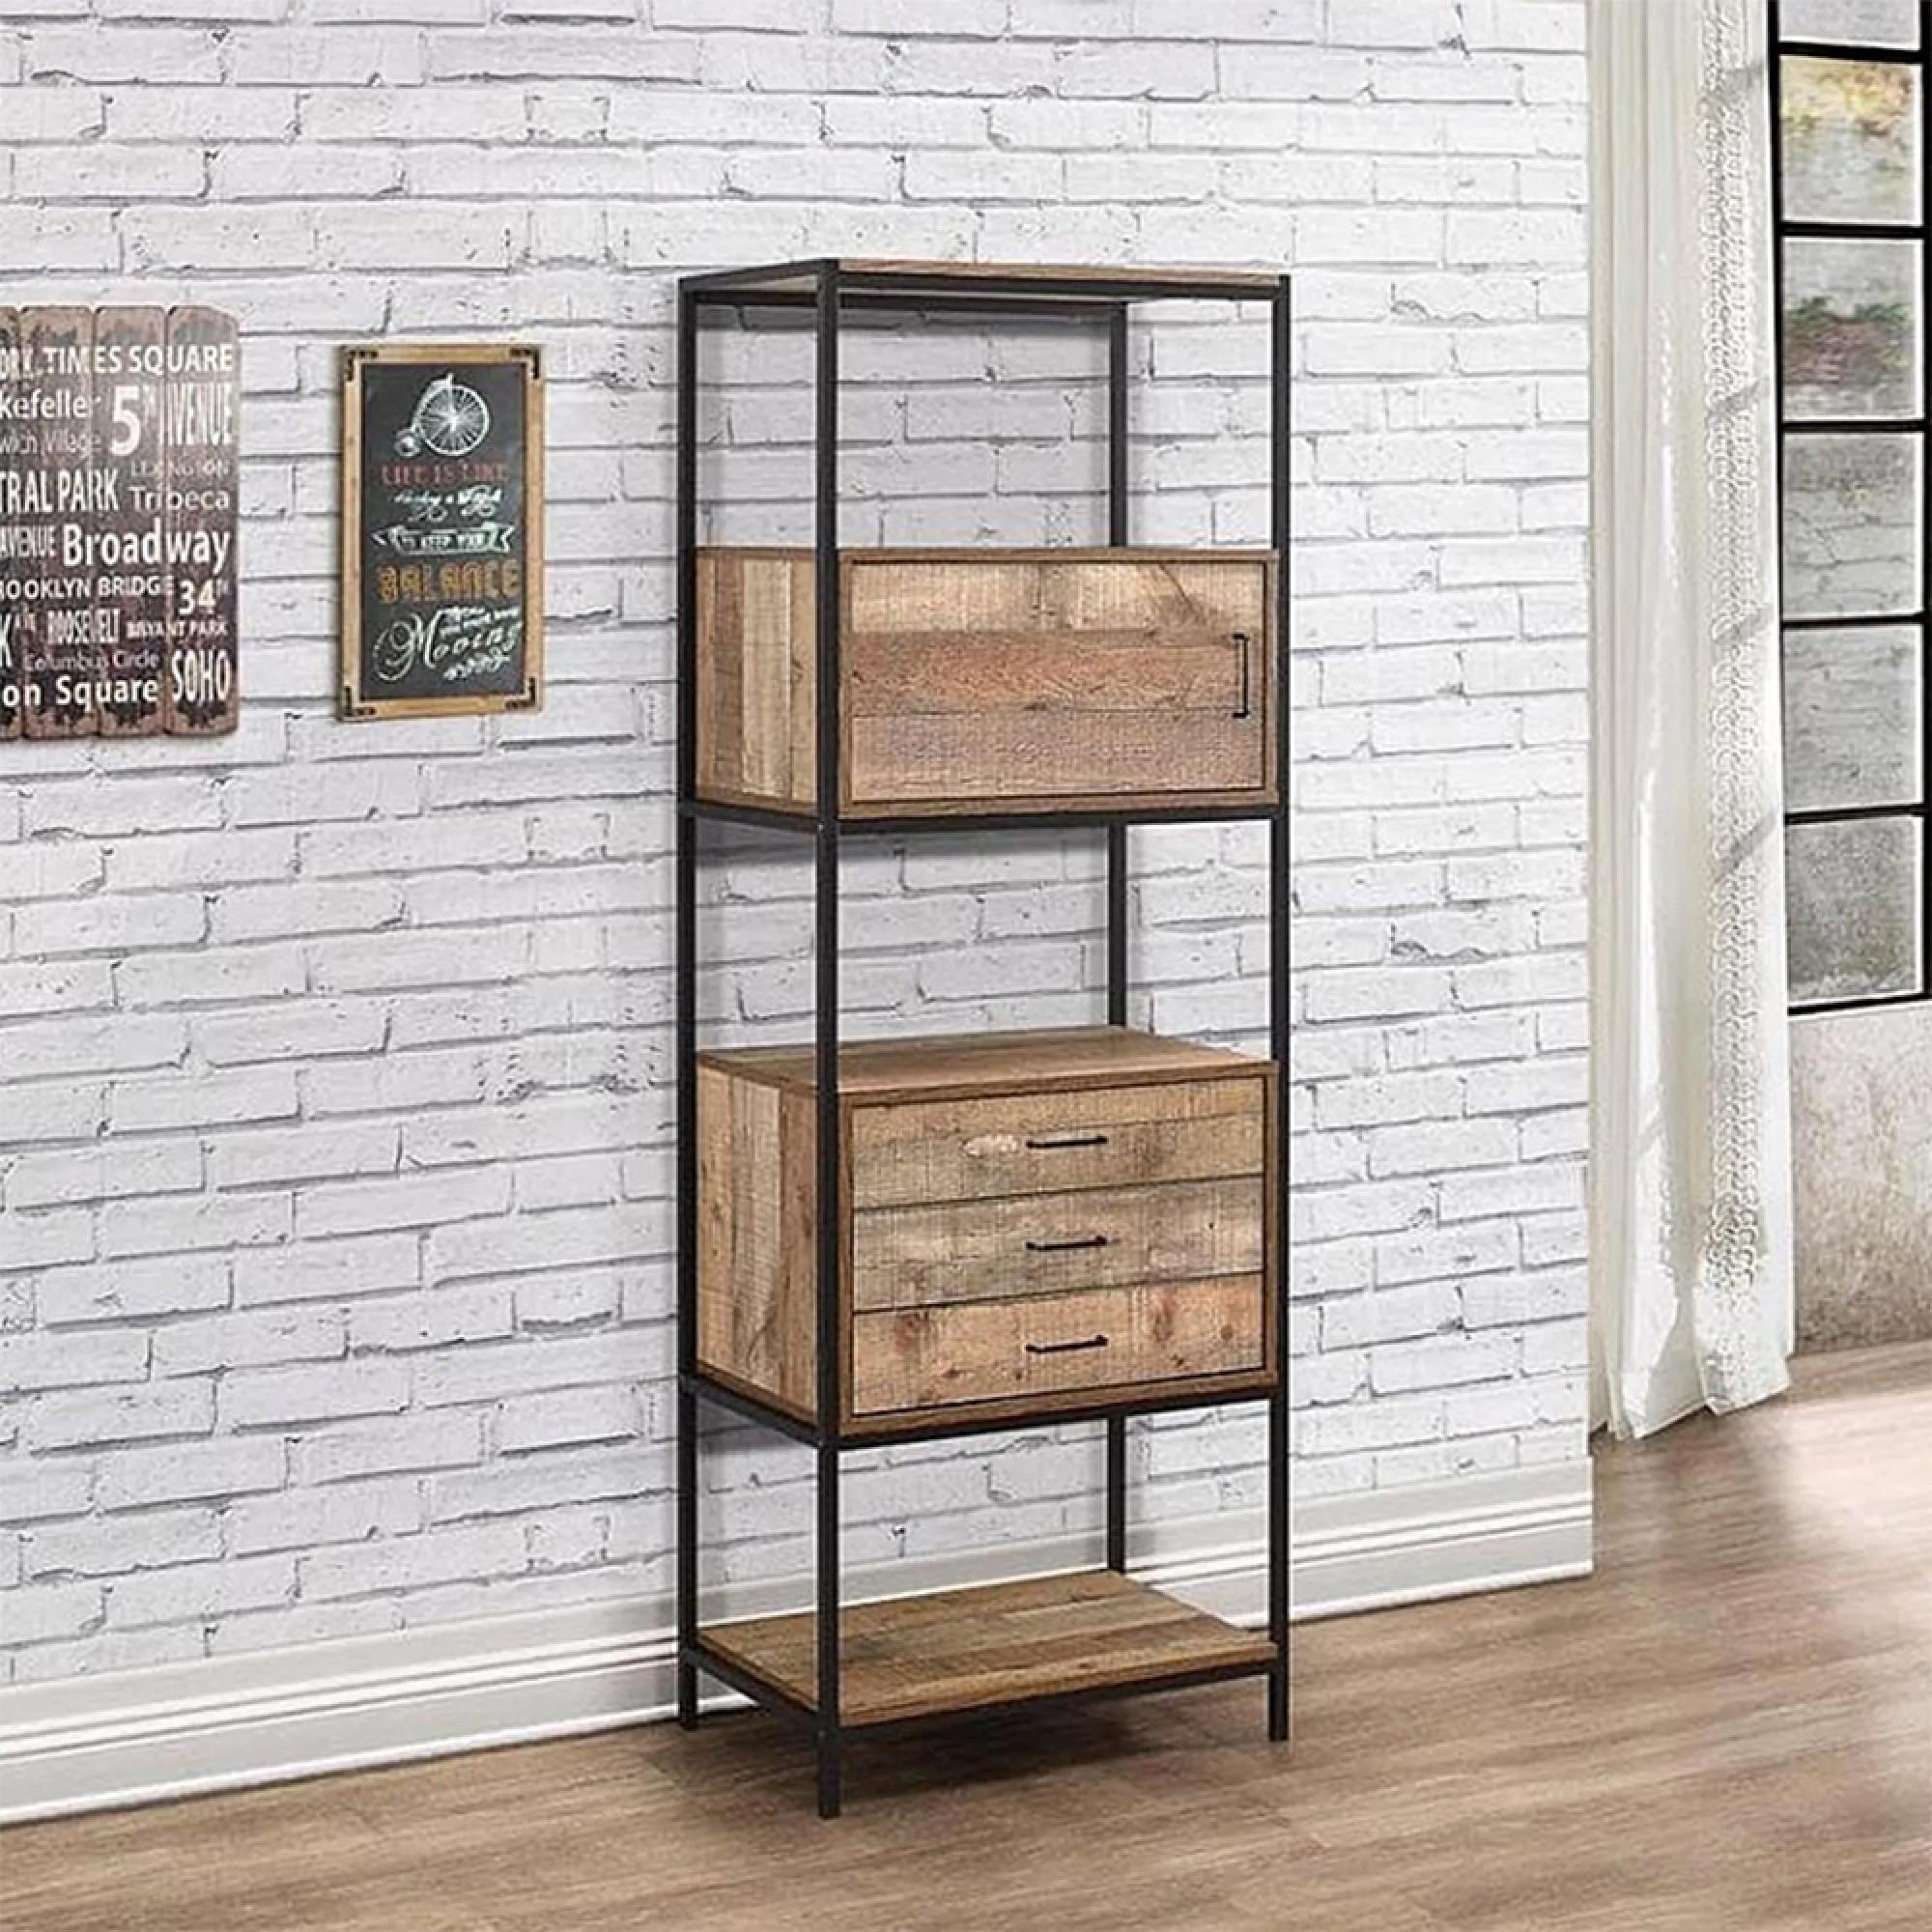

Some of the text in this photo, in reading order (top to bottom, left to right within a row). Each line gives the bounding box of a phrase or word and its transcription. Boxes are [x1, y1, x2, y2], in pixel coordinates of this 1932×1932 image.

[128, 344, 233, 376] SQUARE
[58, 468, 119, 512] PARK
[128, 481, 230, 512] Tribeca
[63, 517, 230, 575] Broadway
[98, 575, 174, 597] BRIDGE
[55, 674, 158, 712] Square
[172, 649, 231, 705] SOHO
